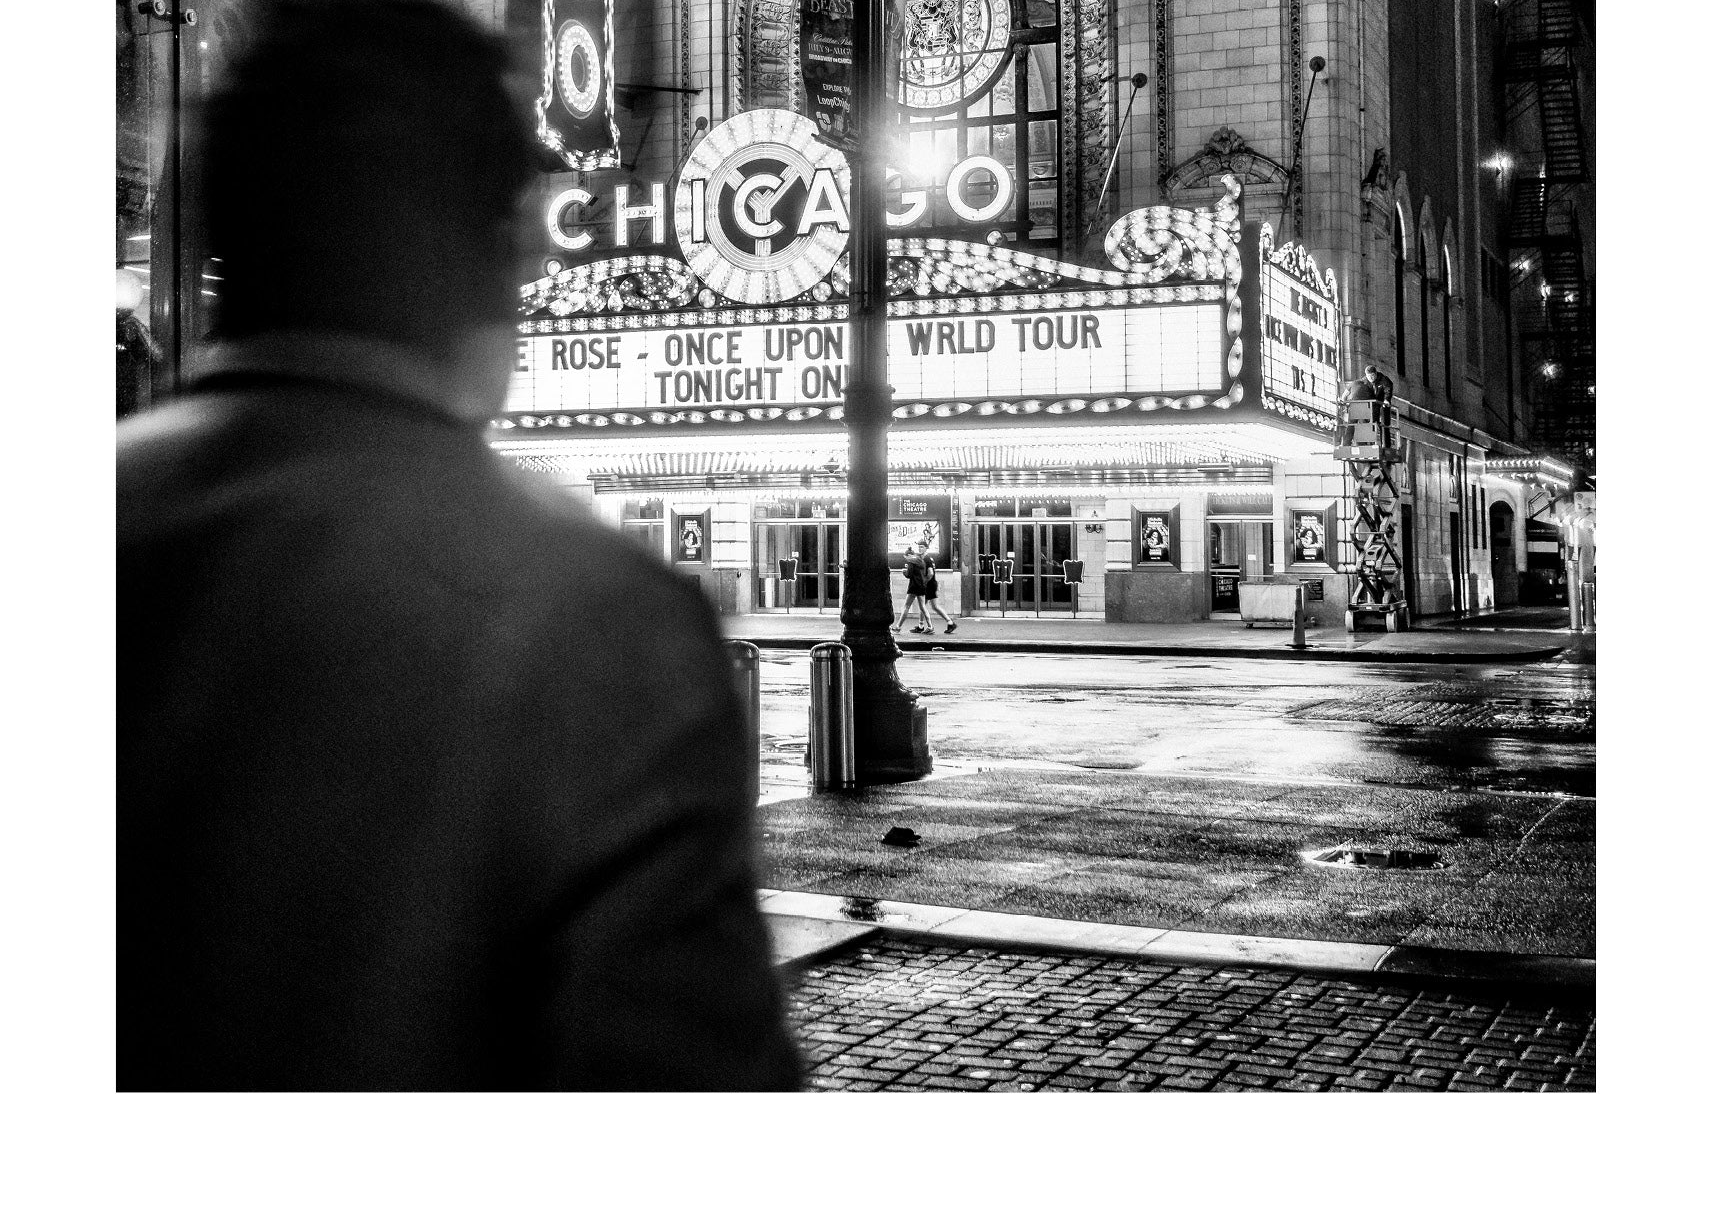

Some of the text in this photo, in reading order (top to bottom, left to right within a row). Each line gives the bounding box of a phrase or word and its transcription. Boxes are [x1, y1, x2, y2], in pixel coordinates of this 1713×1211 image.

[547, 156, 1014, 249] CHICAGO
[551, 336, 621, 371] ROSE
[664, 330, 742, 366] ONCE
[765, 326, 843, 362] UPON
[905, 319, 995, 356] WRLD
[1011, 313, 1102, 353] TOUR
[653, 366, 783, 404] TONIGHT
